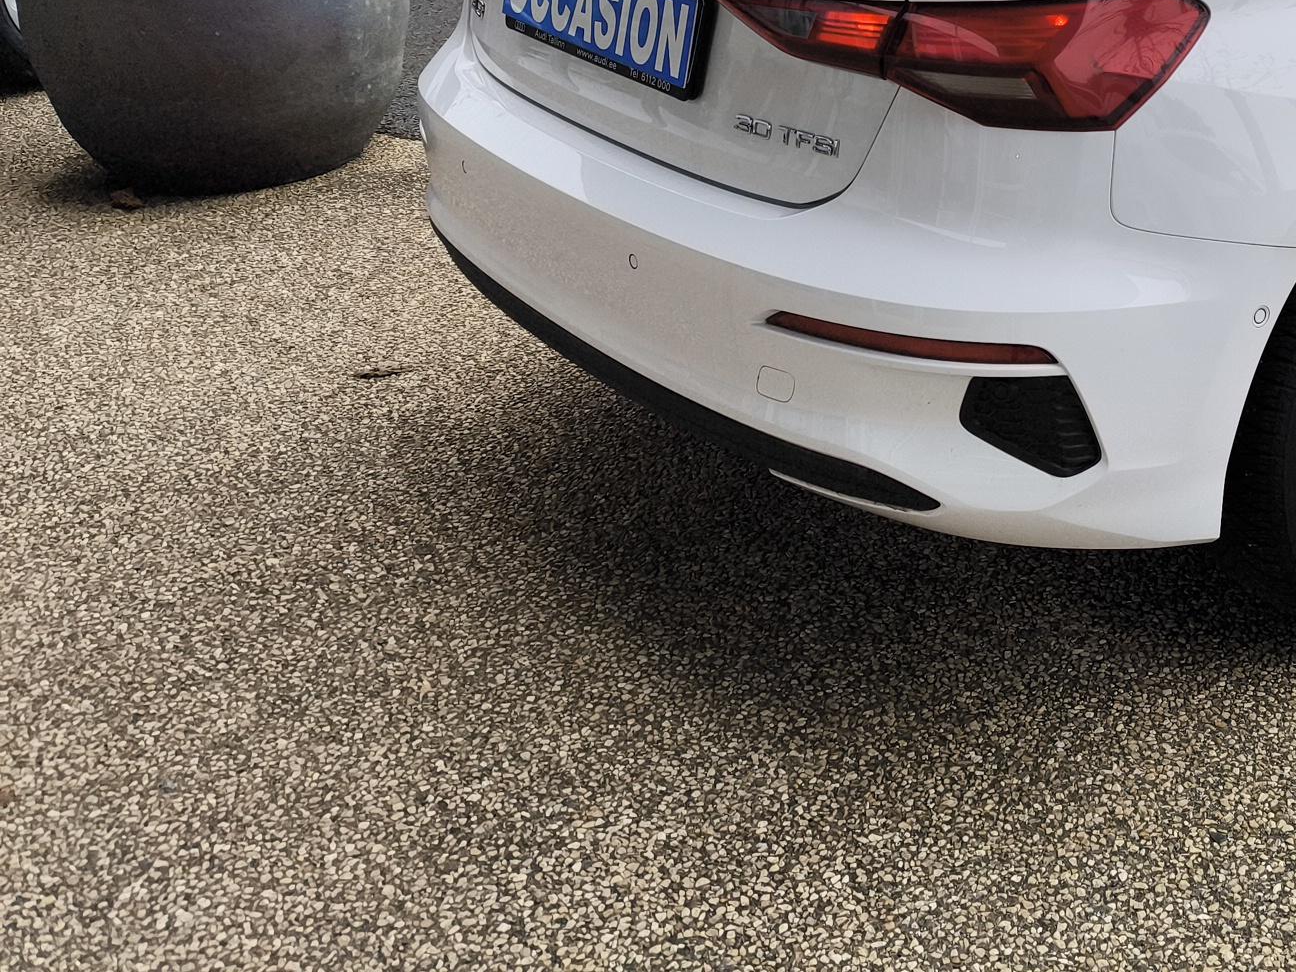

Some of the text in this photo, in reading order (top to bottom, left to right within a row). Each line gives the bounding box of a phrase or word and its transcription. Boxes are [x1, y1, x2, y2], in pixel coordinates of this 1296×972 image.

[535, 30, 547, 41] Audi
[576, 48, 617, 70] www.audi.ee
[734, 114, 841, 158] 30 TFSI
